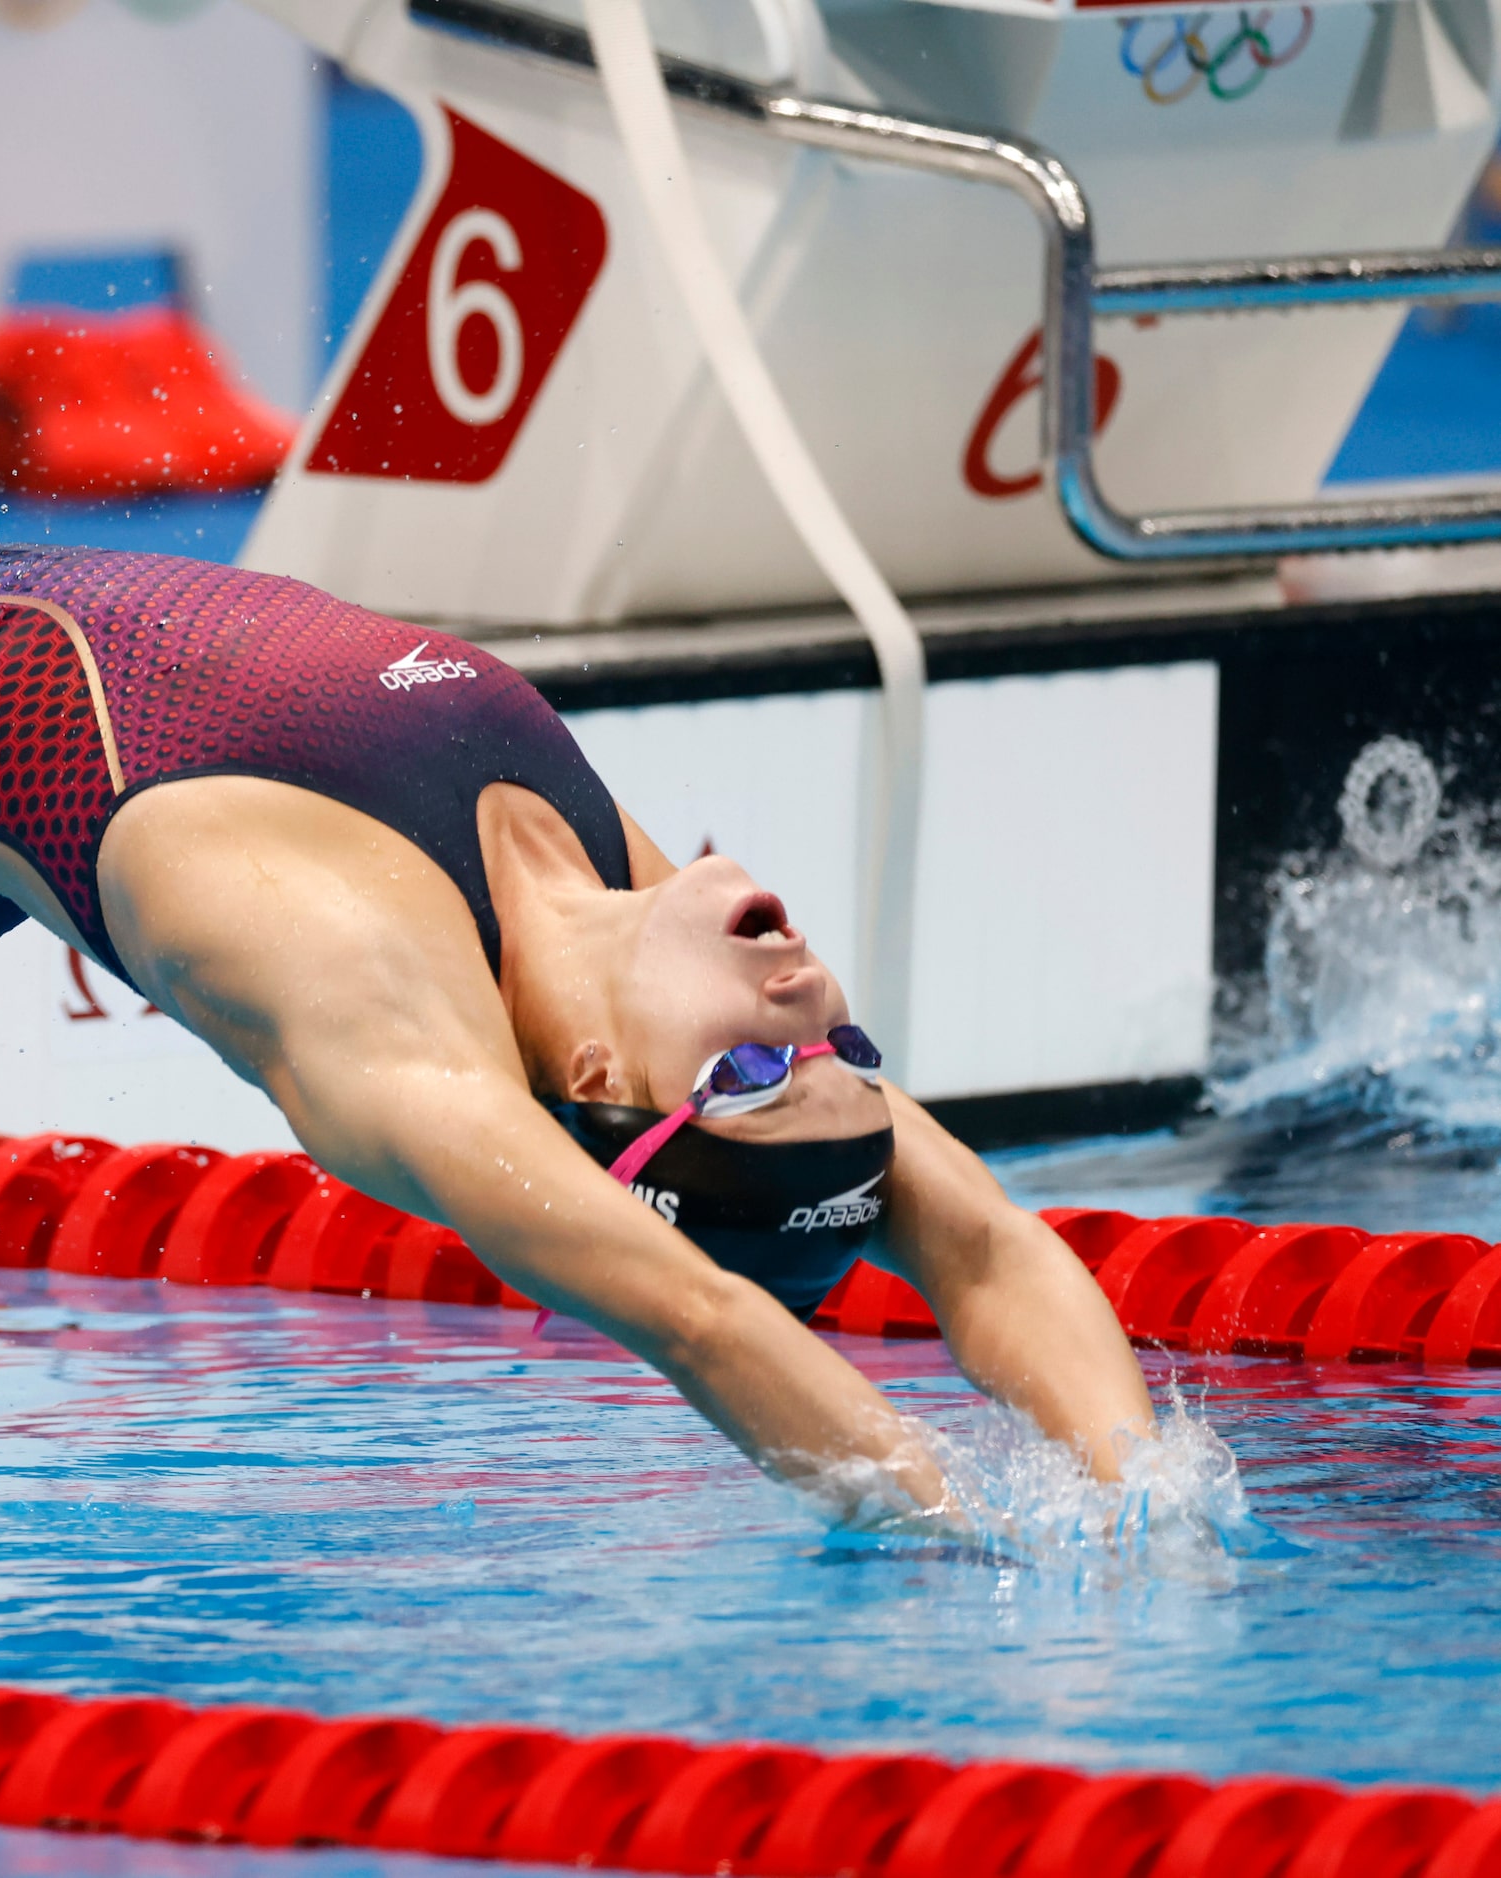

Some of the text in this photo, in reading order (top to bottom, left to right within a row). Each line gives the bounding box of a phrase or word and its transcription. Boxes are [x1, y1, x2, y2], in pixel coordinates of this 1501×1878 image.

[427, 207, 525, 427] 6
[379, 658, 477, 692] speedo
[787, 1196, 883, 1233] speedo
